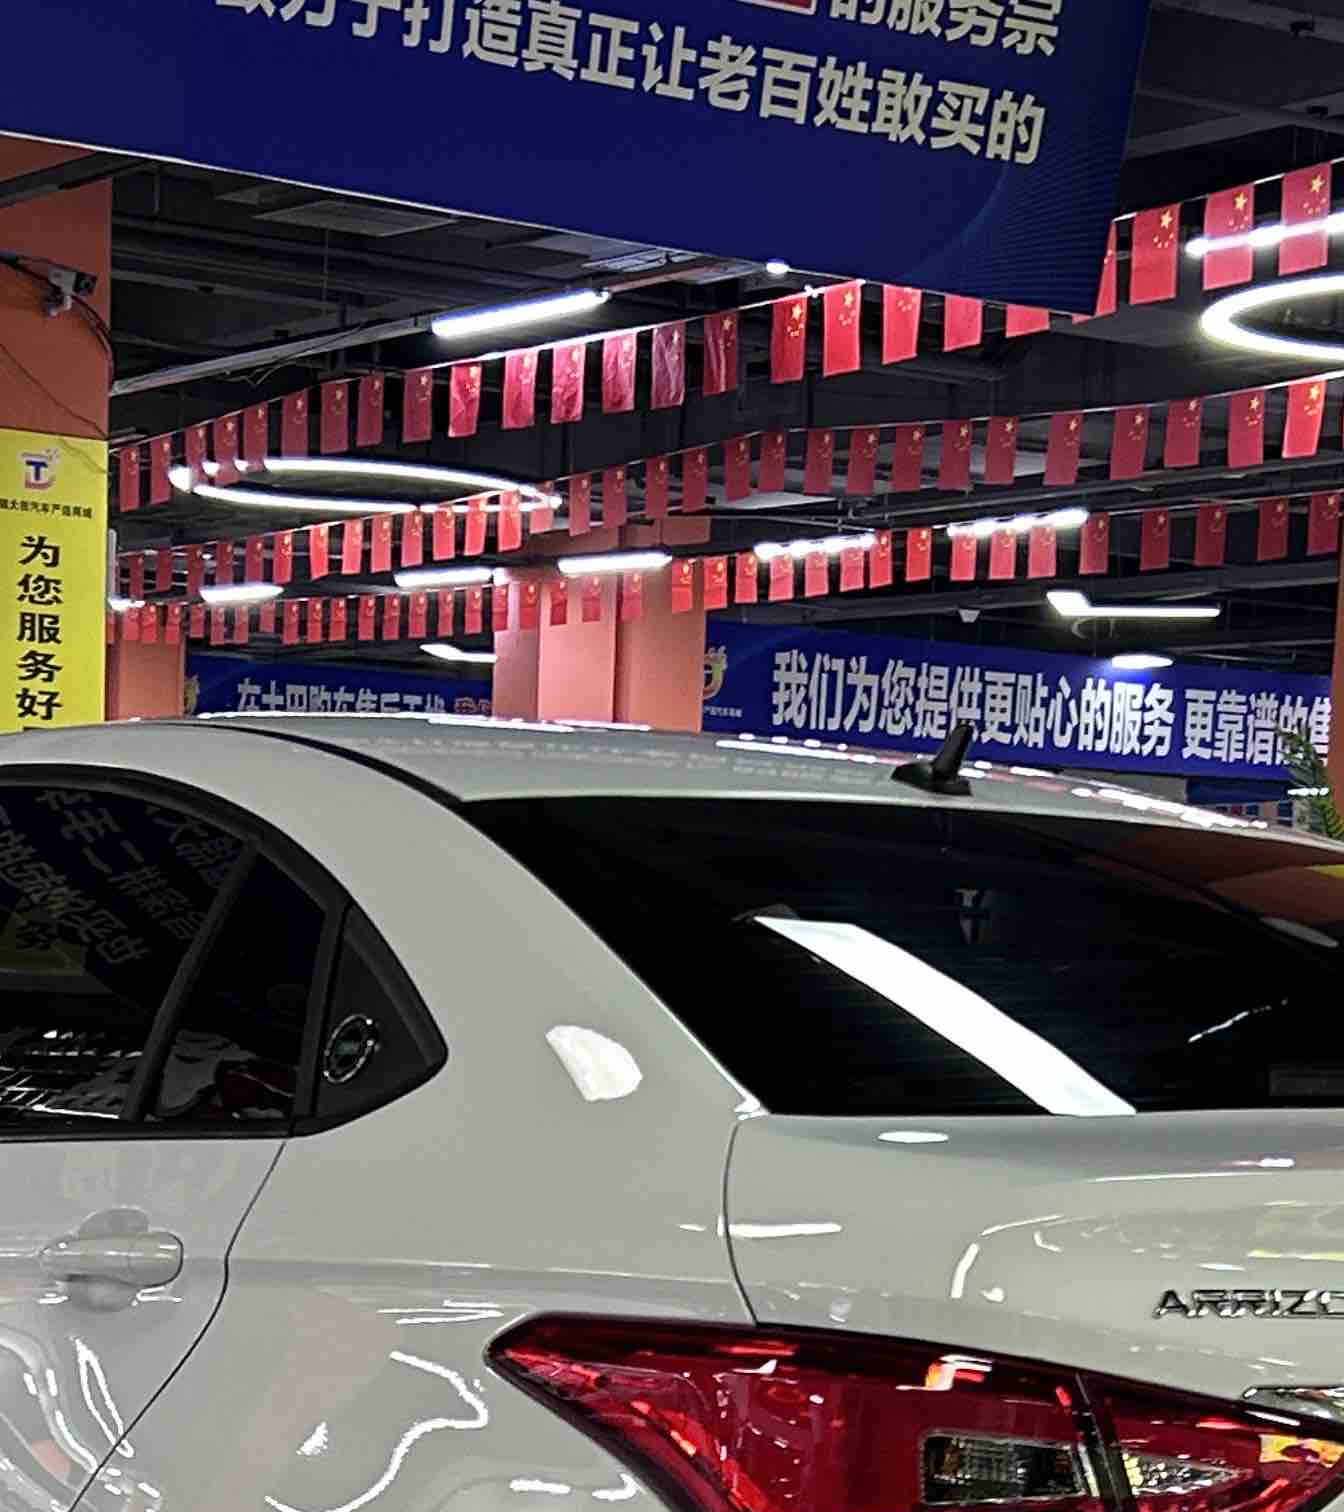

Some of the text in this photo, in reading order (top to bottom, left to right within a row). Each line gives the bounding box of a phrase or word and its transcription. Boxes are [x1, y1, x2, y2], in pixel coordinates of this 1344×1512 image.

[216, 0, 1046, 164] 于打造真正让老百姓敢买的
[16, 535, 64, 721] 为您服务好
[771, 649, 1175, 757] 我们为您提供更贴心的服务
